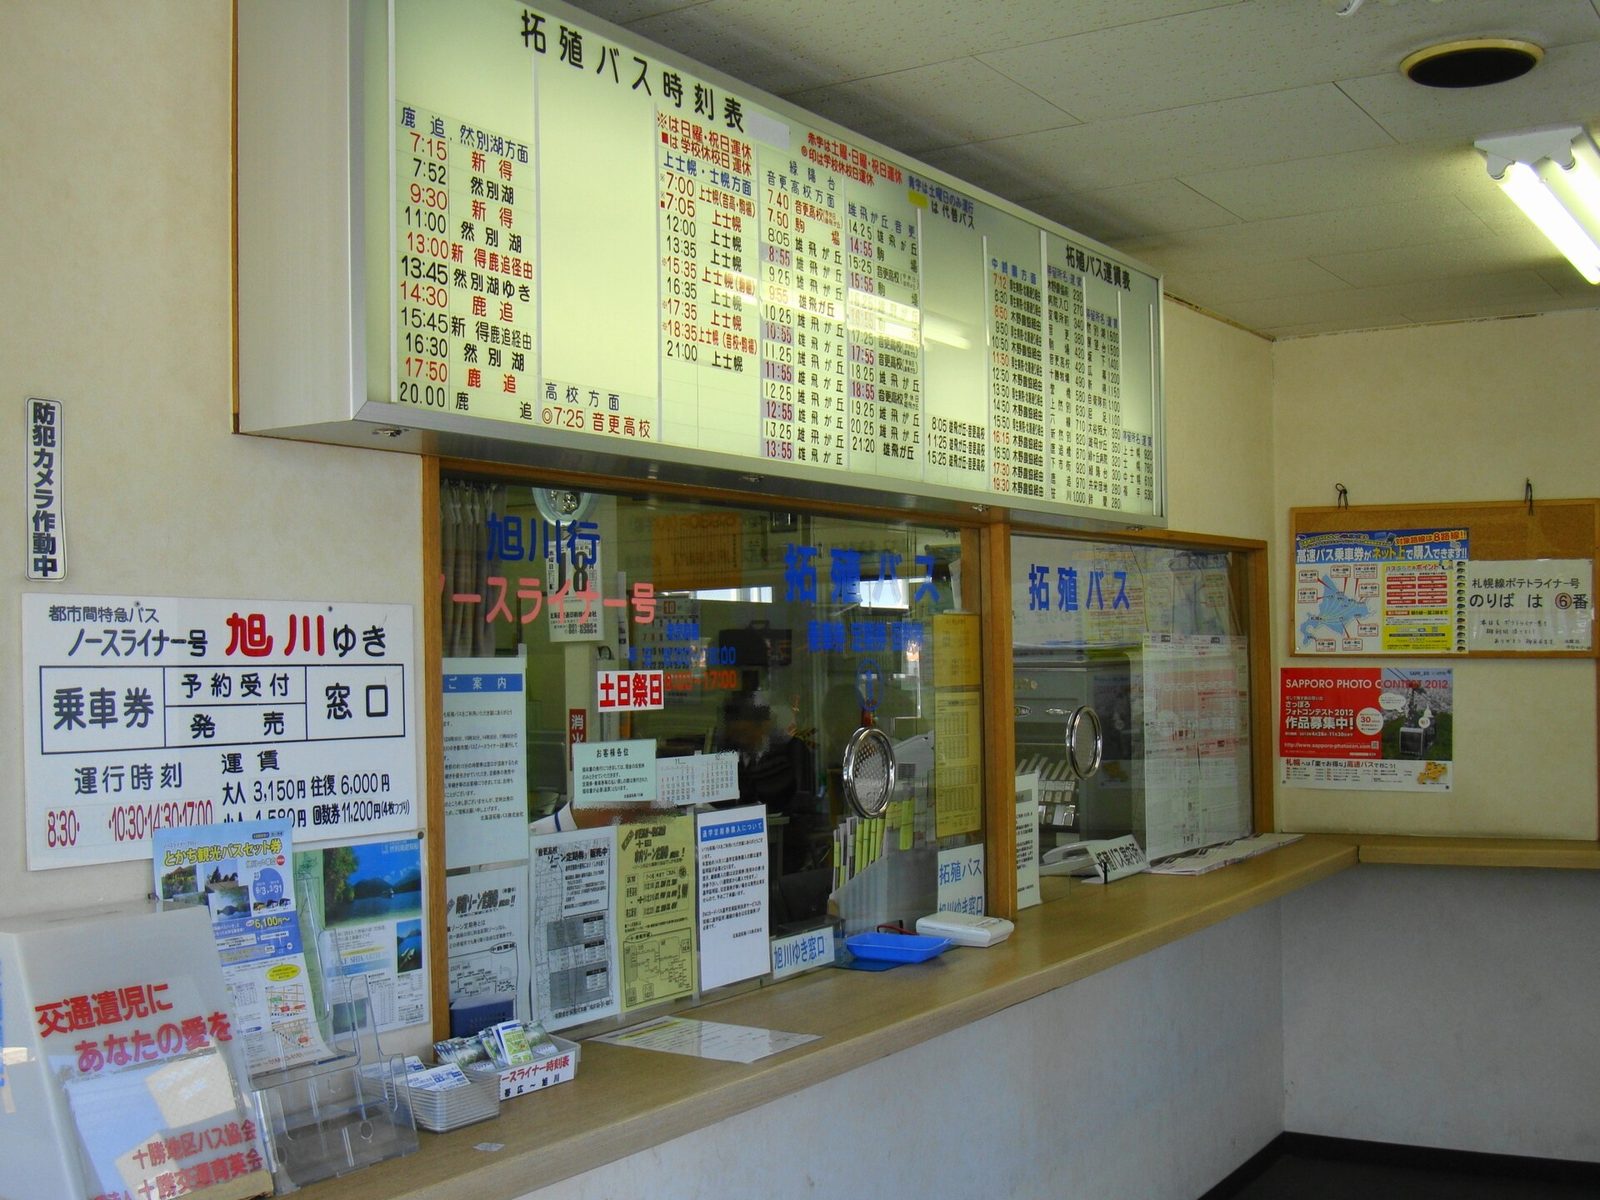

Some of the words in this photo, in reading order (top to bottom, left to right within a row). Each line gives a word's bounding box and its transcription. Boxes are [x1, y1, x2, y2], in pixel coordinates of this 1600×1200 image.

[521, 10, 744, 133] 拓殖バス時刻表
[410, 132, 446, 160] 7:15
[472, 151, 512, 181] 新得
[413, 158, 446, 185] 7:52
[470, 176, 514, 205] 然別湖
[666, 172, 694, 197] 7:00
[410, 184, 447, 210] 9:30
[472, 200, 513, 228] 新得
[666, 192, 695, 217] 7:05
[712, 210, 742, 232] 上士幌
[405, 206, 446, 234] 11:00
[461, 221, 522, 253] 然別湖
[408, 232, 448, 260] 13:00
[667, 214, 696, 238] 12:00
[711, 229, 742, 252] 上士幌
[667, 235, 696, 258] 13:35
[711, 249, 742, 272] 上士幌
[667, 256, 696, 280] 15:35
[402, 255, 448, 285] 13:45
[453, 268, 530, 302] 然別湖ゆき
[668, 277, 696, 300] 16:35
[712, 289, 742, 312] 上士幌
[401, 281, 448, 308] 14:30
[472, 296, 513, 322] 鹿追
[668, 298, 697, 320] 17:35
[711, 310, 742, 332] 上士幌
[402, 307, 448, 334] 15:45
[668, 320, 697, 342] 18:35
[406, 332, 448, 358] 16:30
[464, 344, 524, 372] 然別湖
[667, 340, 697, 362] 21:00
[712, 351, 743, 372] 上士幌
[406, 357, 448, 382] 17:50
[468, 368, 516, 394] 鹿追
[546, 382, 620, 411] 高校方面
[593, 412, 650, 438] 音更高校
[32, 401, 57, 578] 防犯カメラ作動中
[487, 513, 600, 564] 旭川行
[784, 544, 940, 602] 拓殖バス
[1029, 564, 1130, 612] 拓殖バス
[48, 606, 160, 624] 都市間特急バス
[1470, 592, 1514, 608] のりば
[1528, 594, 1542, 608] は
[67, 627, 208, 658] ノースライナー号
[181, 672, 290, 698] 予約受付
[448, 676, 506, 690] ご案内
[600, 673, 662, 708] 土日祭日
[1286, 679, 1334, 689] SAPPORO
[1336, 679, 1372, 689] PHOTO
[1426, 680, 1448, 689] 2012
[54, 686, 154, 730] 乗車券
[325, 682, 388, 720] 窓口
[190, 710, 284, 738] 発売
[1286, 716, 1354, 730] 作品募集中!
[74, 762, 182, 795] 運行時刻
[221, 750, 280, 774] 運賃
[222, 781, 246, 806] 大人
[253, 779, 306, 802] 3,150円
[311, 774, 336, 798] 往復
[341, 773, 390, 795] 6,000円
[312, 803, 340, 826] 回数券
[164, 838, 283, 867] とかち観光バスセット券
[939, 858, 982, 886] 拓殖バス
[774, 936, 825, 970] 旭川ゆき窓口
[34, 984, 174, 1038] 交通遺児に
[75, 1012, 232, 1073] あなたの愛を
[501, 1055, 570, 1083] ースライナー時刻表
[132, 1119, 257, 1170] 十勝地区バス協会
